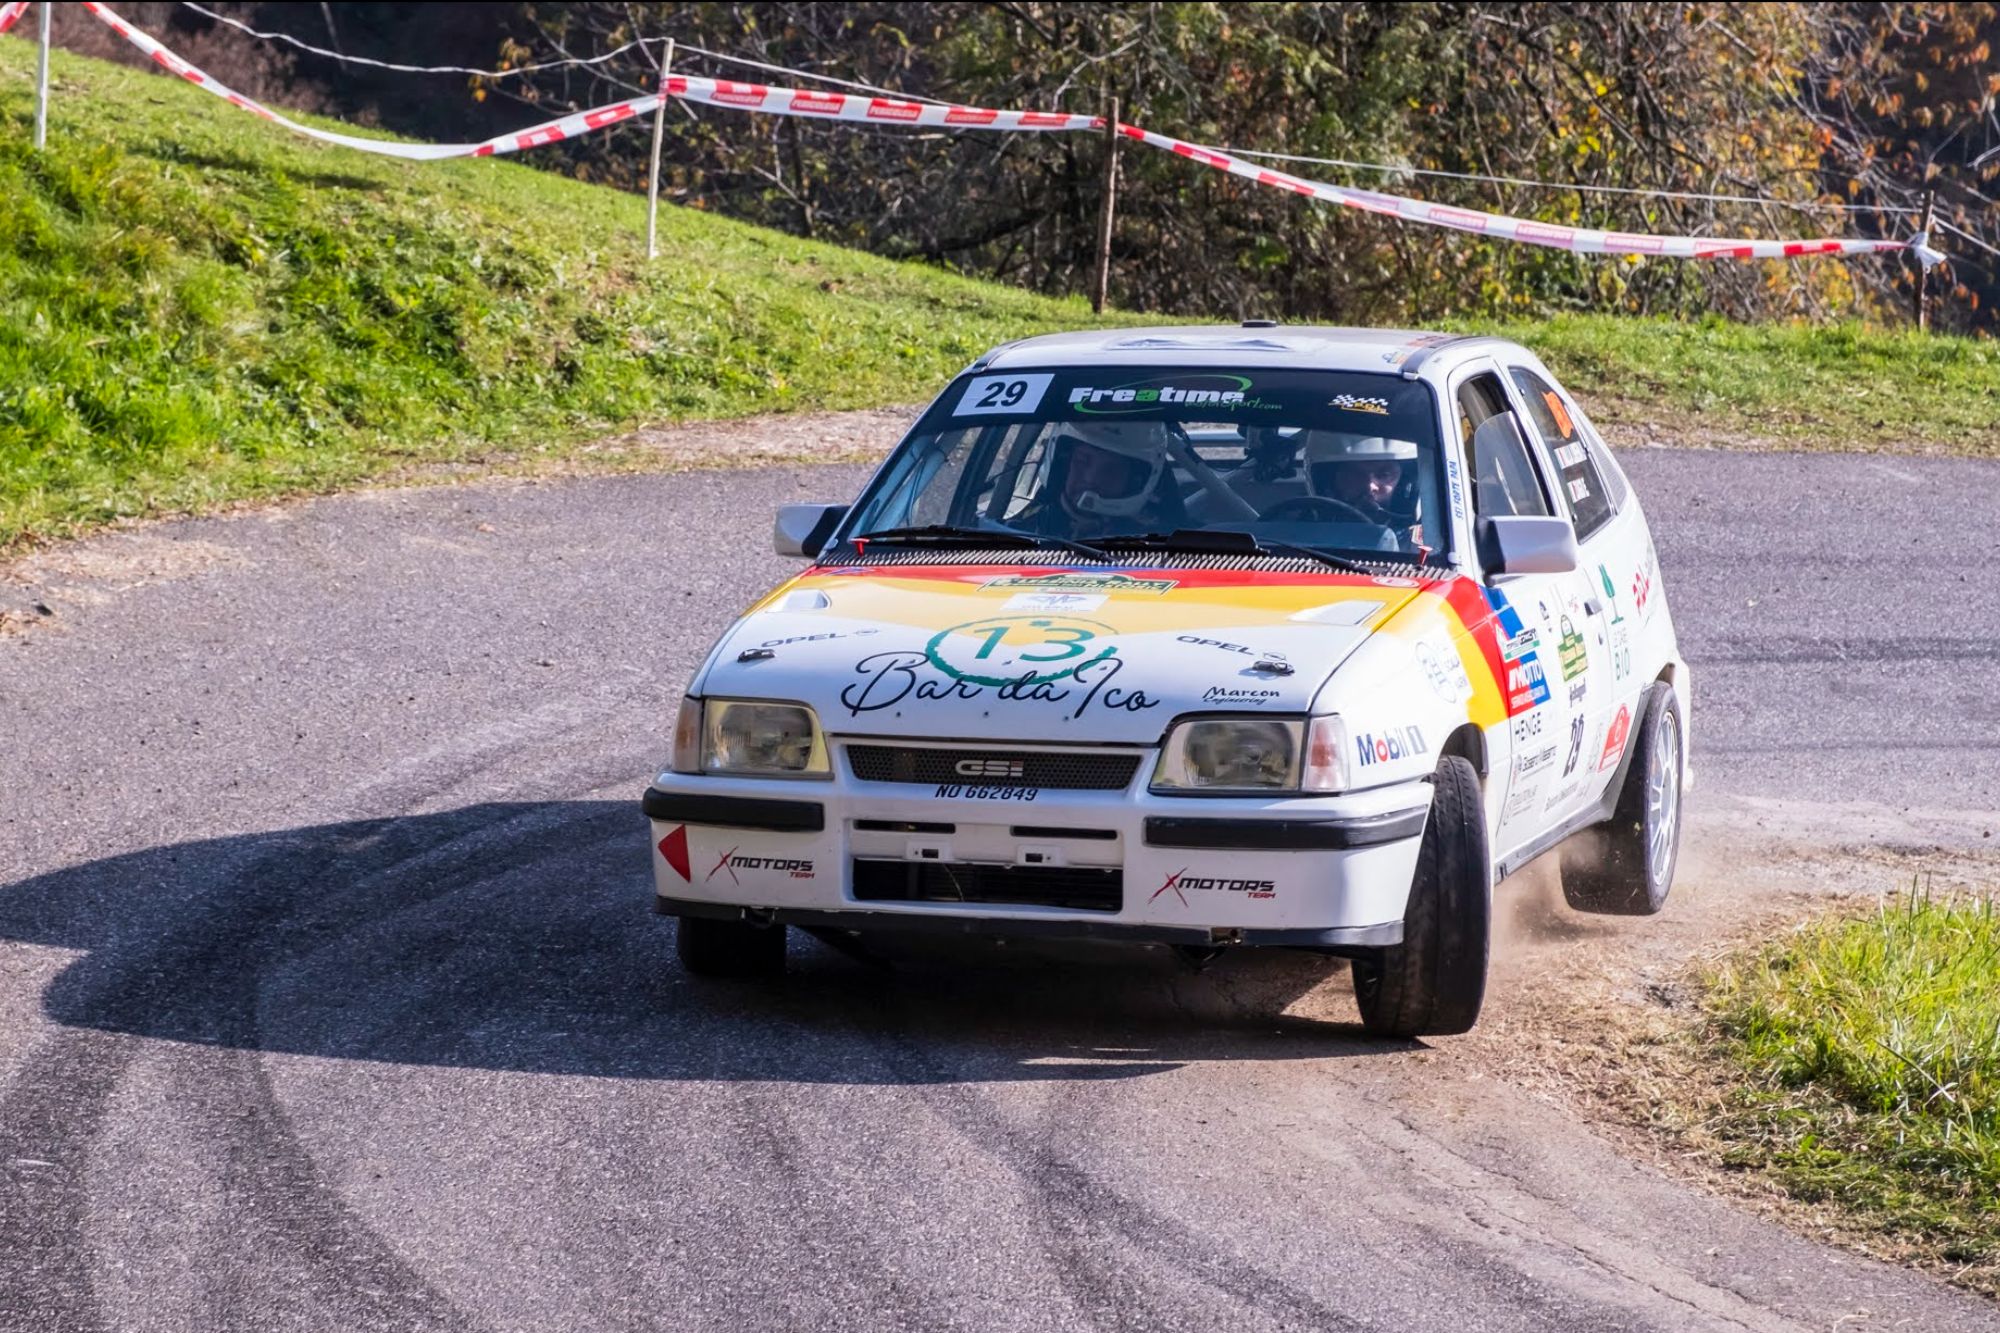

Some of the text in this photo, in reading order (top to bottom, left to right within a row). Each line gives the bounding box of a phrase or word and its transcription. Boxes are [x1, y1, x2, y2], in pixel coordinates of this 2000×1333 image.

[975, 381, 1028, 407] 29
[761, 633, 848, 648] OPEL
[974, 626, 1096, 662] 13
[1176, 635, 1255, 656] OPEL
[840, 651, 1161, 719] Bar da Ico
[1202, 686, 1280, 699] Marcon
[1356, 726, 1410, 767] Mobil
[965, 785, 1039, 801] 662849
[790, 871, 815, 879] TEAM
